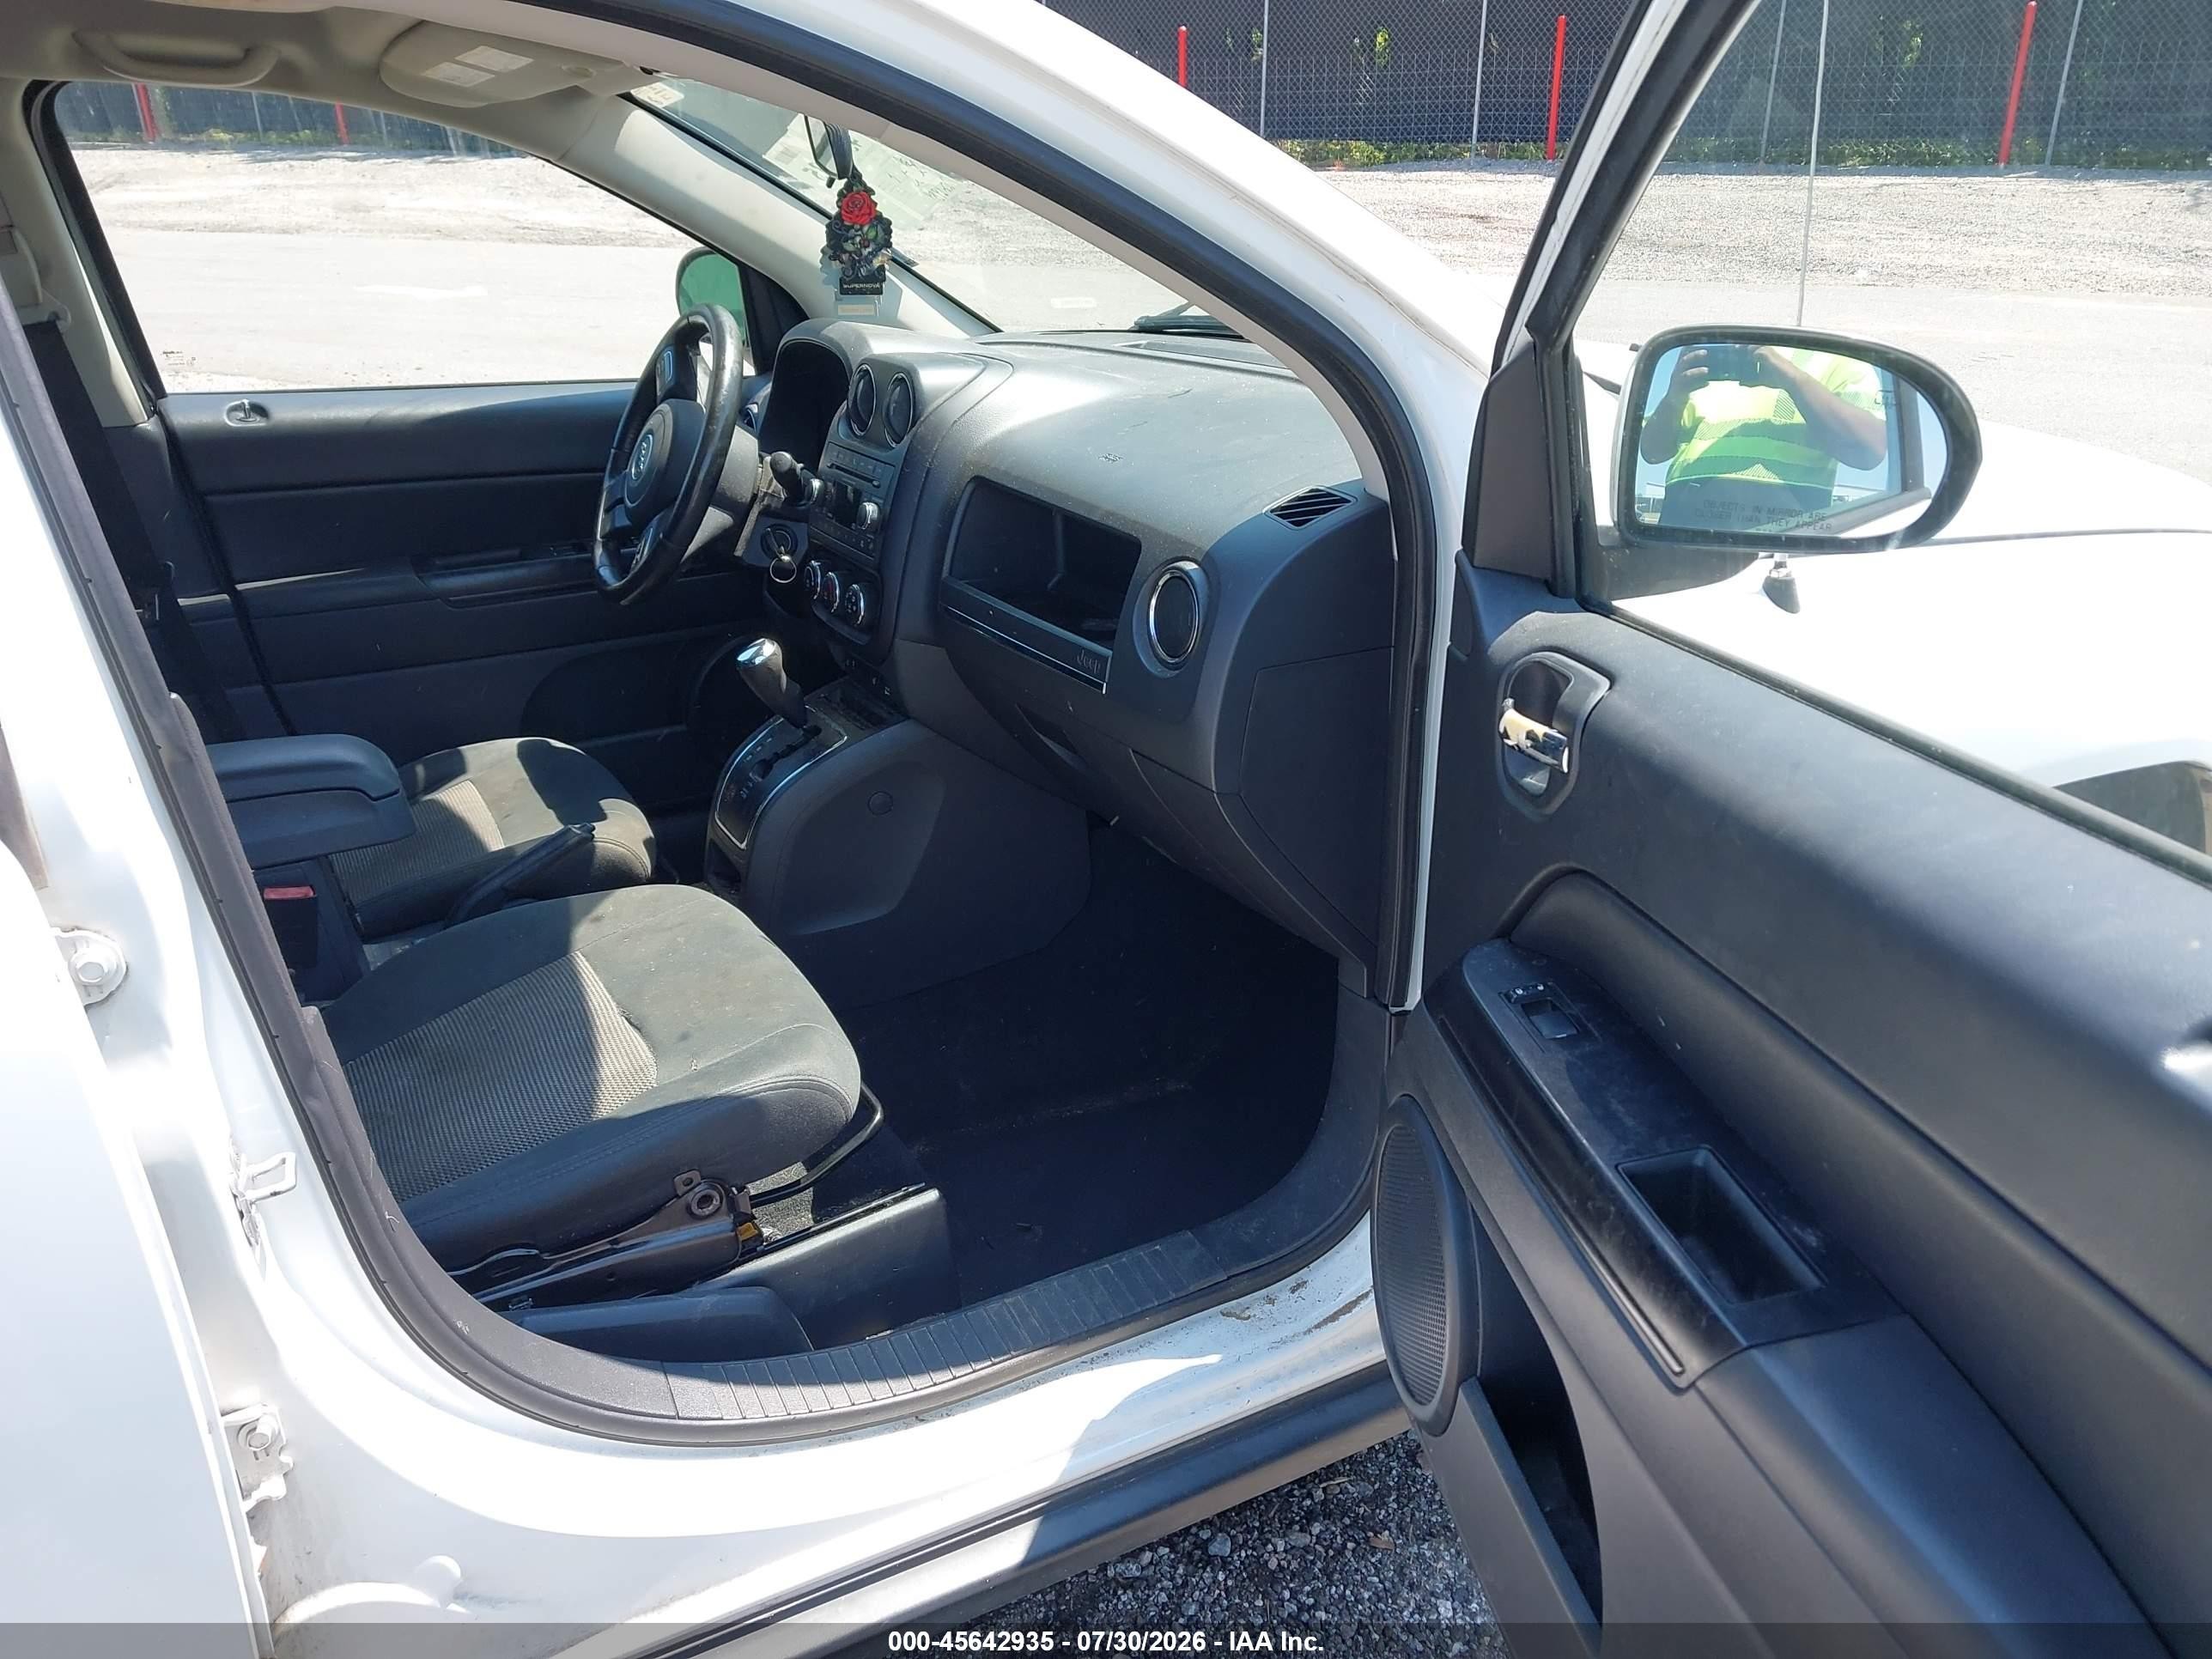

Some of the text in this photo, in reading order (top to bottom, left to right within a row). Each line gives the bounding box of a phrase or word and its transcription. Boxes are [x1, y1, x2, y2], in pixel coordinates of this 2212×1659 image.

[1695, 508, 1832, 531] CLOSER THAN THEY APPEAR
[1703, 500, 1828, 521] OBJECTS IN MIRROR ARE
[1077, 649, 1101, 673] Jeep
